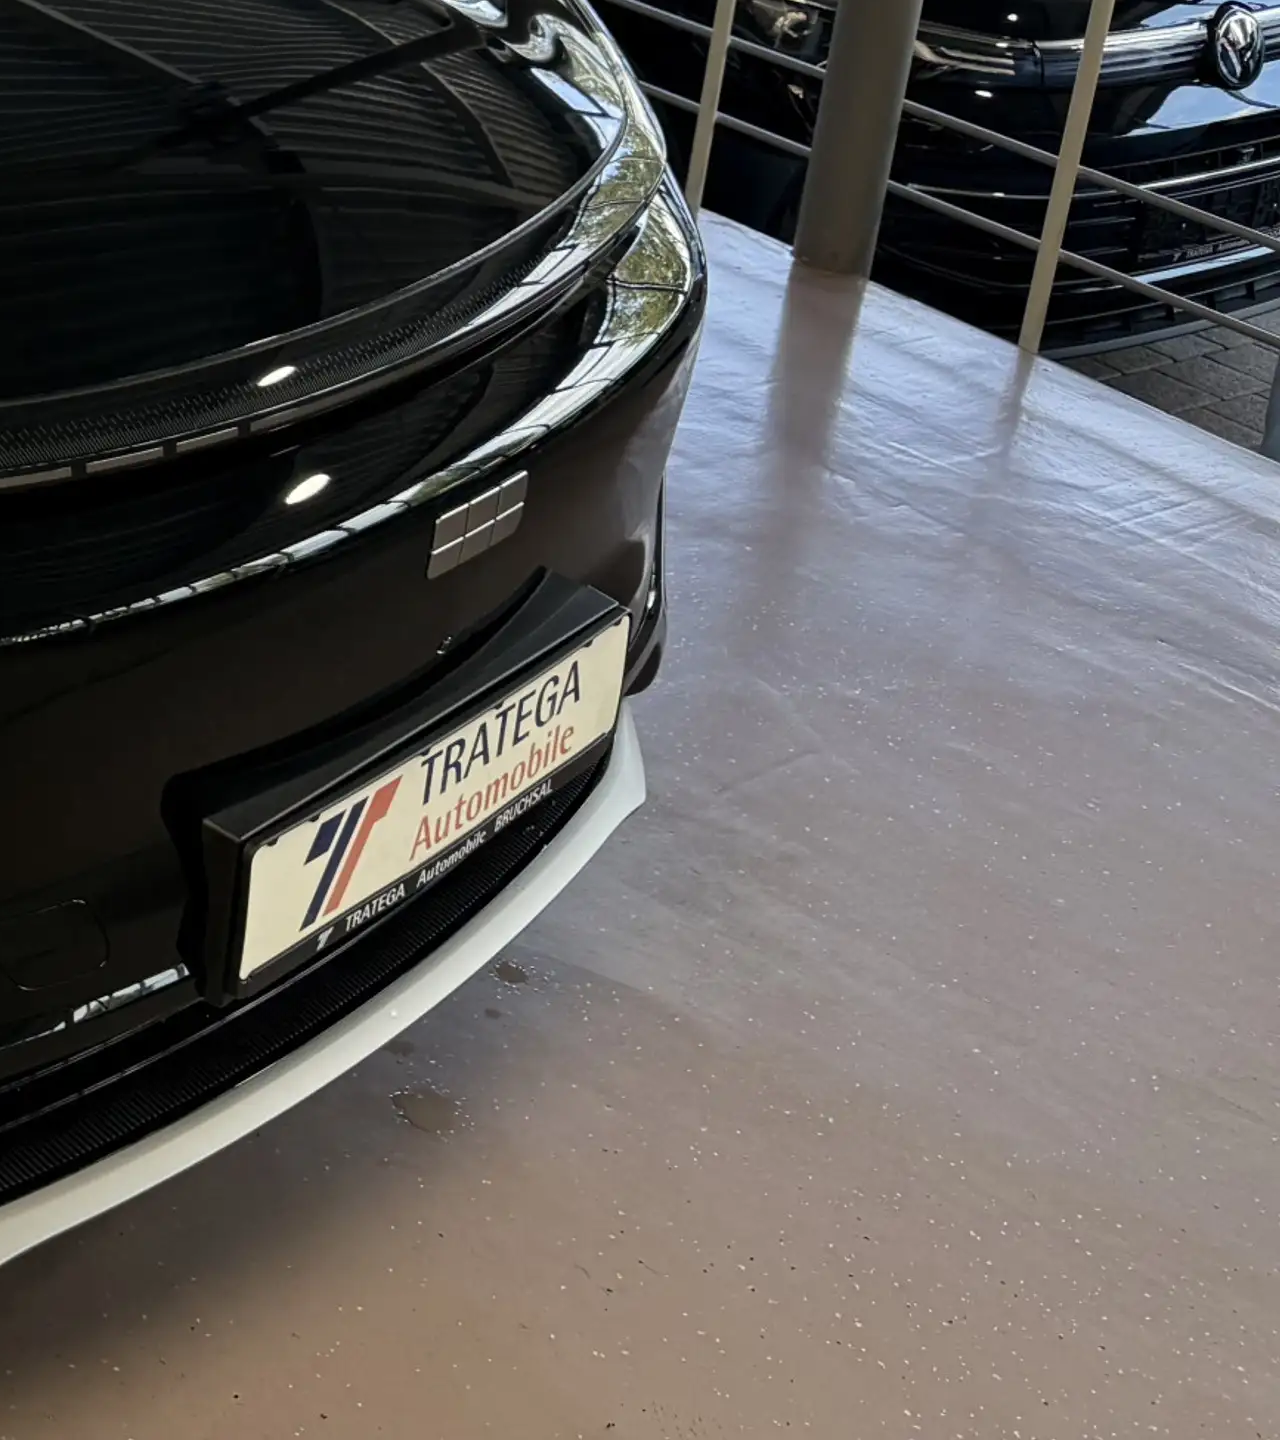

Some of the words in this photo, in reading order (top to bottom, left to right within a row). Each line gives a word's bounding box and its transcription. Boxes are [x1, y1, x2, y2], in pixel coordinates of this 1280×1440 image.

[409, 724, 575, 861] Automobile
[420, 660, 581, 806] TRATEGA
[345, 884, 406, 931] TRATEGA
[416, 831, 487, 888] Automobile
[493, 779, 553, 832] BRUCHSAL
